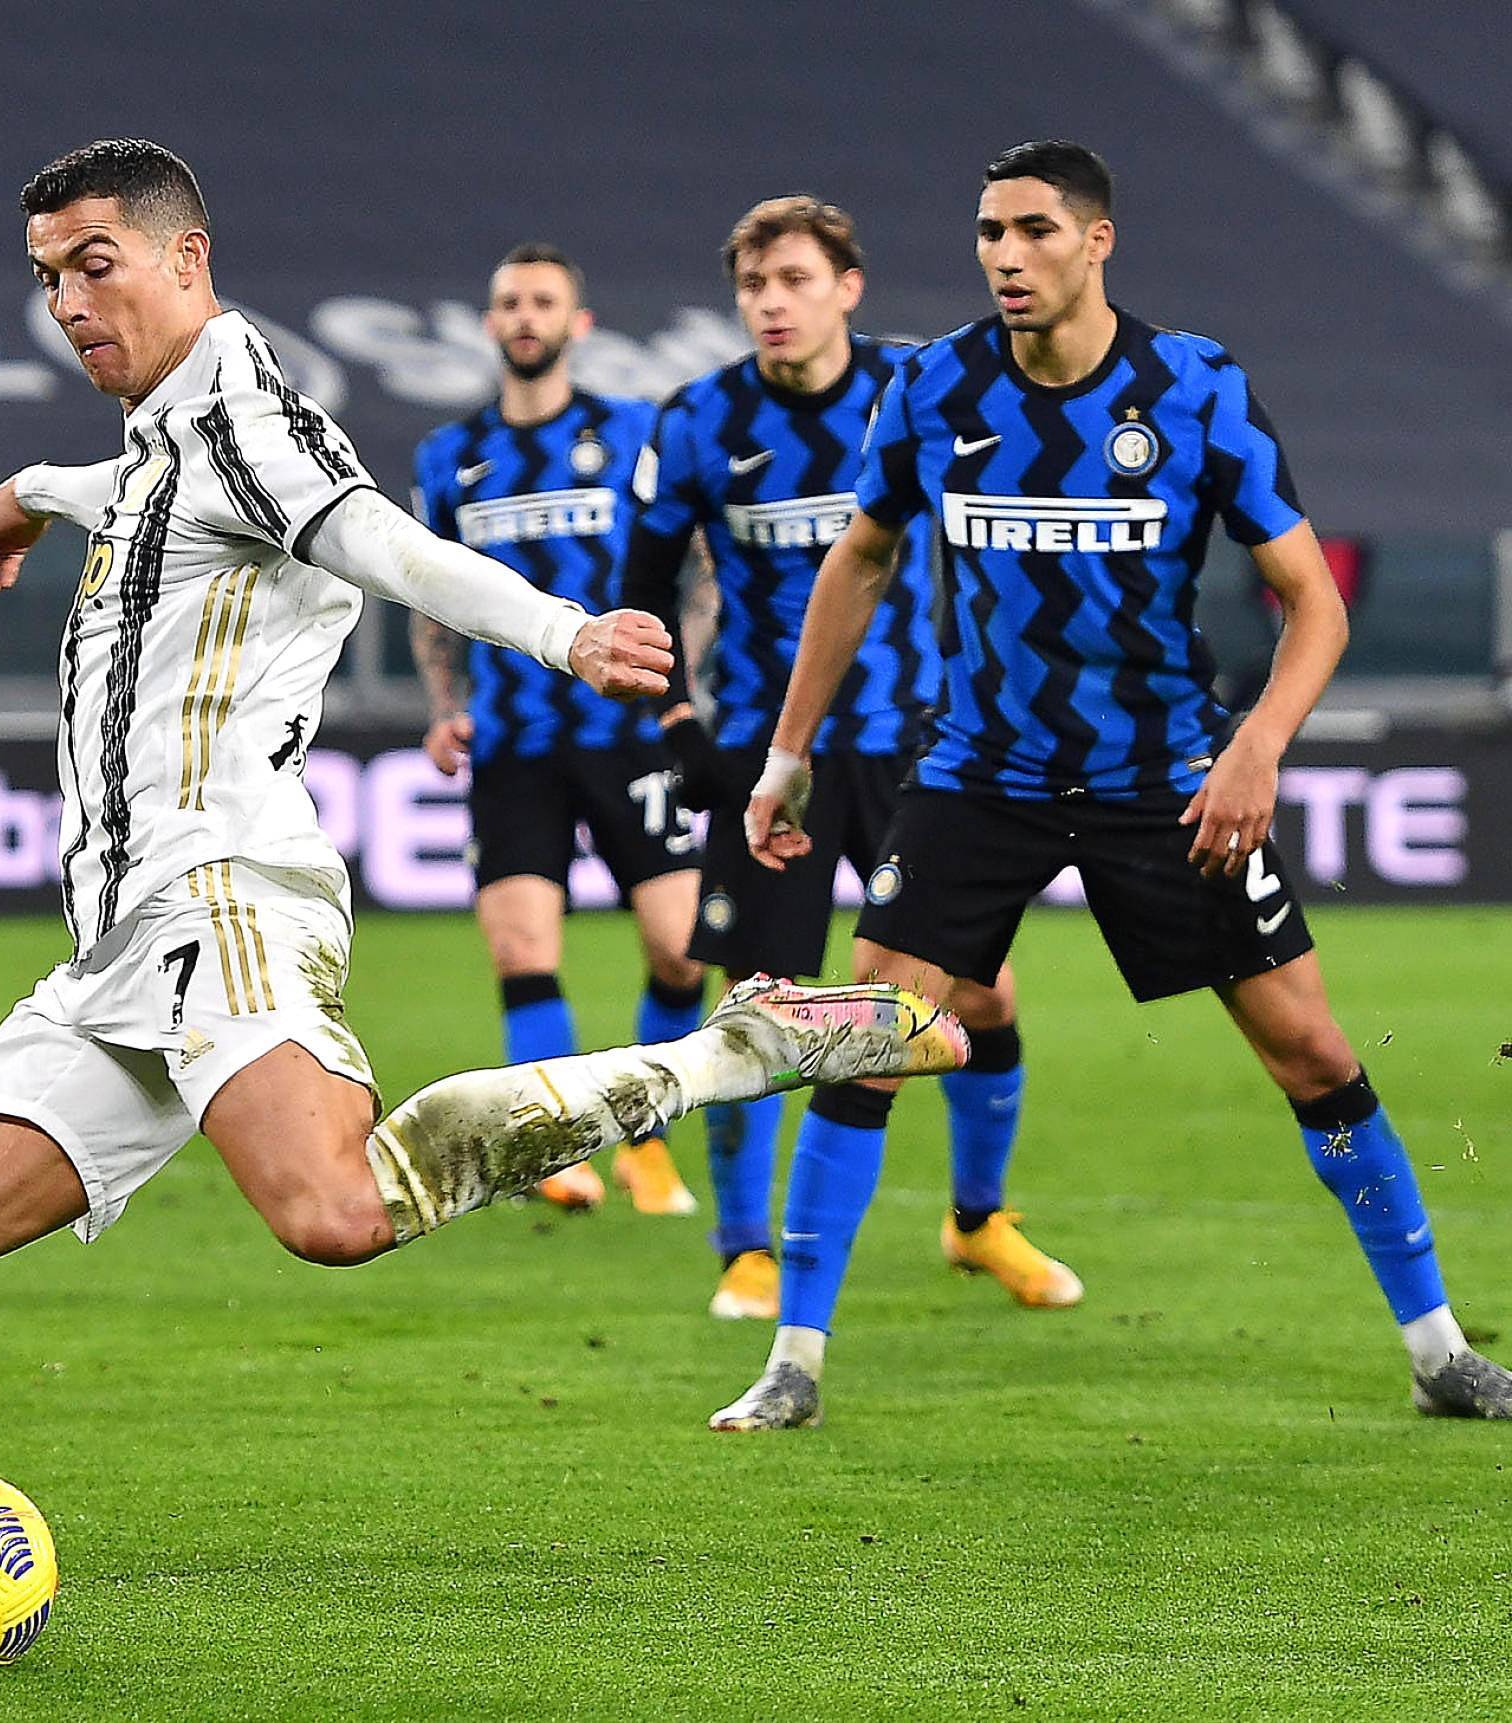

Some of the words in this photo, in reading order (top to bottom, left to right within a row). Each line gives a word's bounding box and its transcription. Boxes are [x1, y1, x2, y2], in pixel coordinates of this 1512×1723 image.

[724, 491, 858, 549] PIRE
[942, 491, 1169, 552] PIRELLI
[158, 938, 201, 1031] 7
